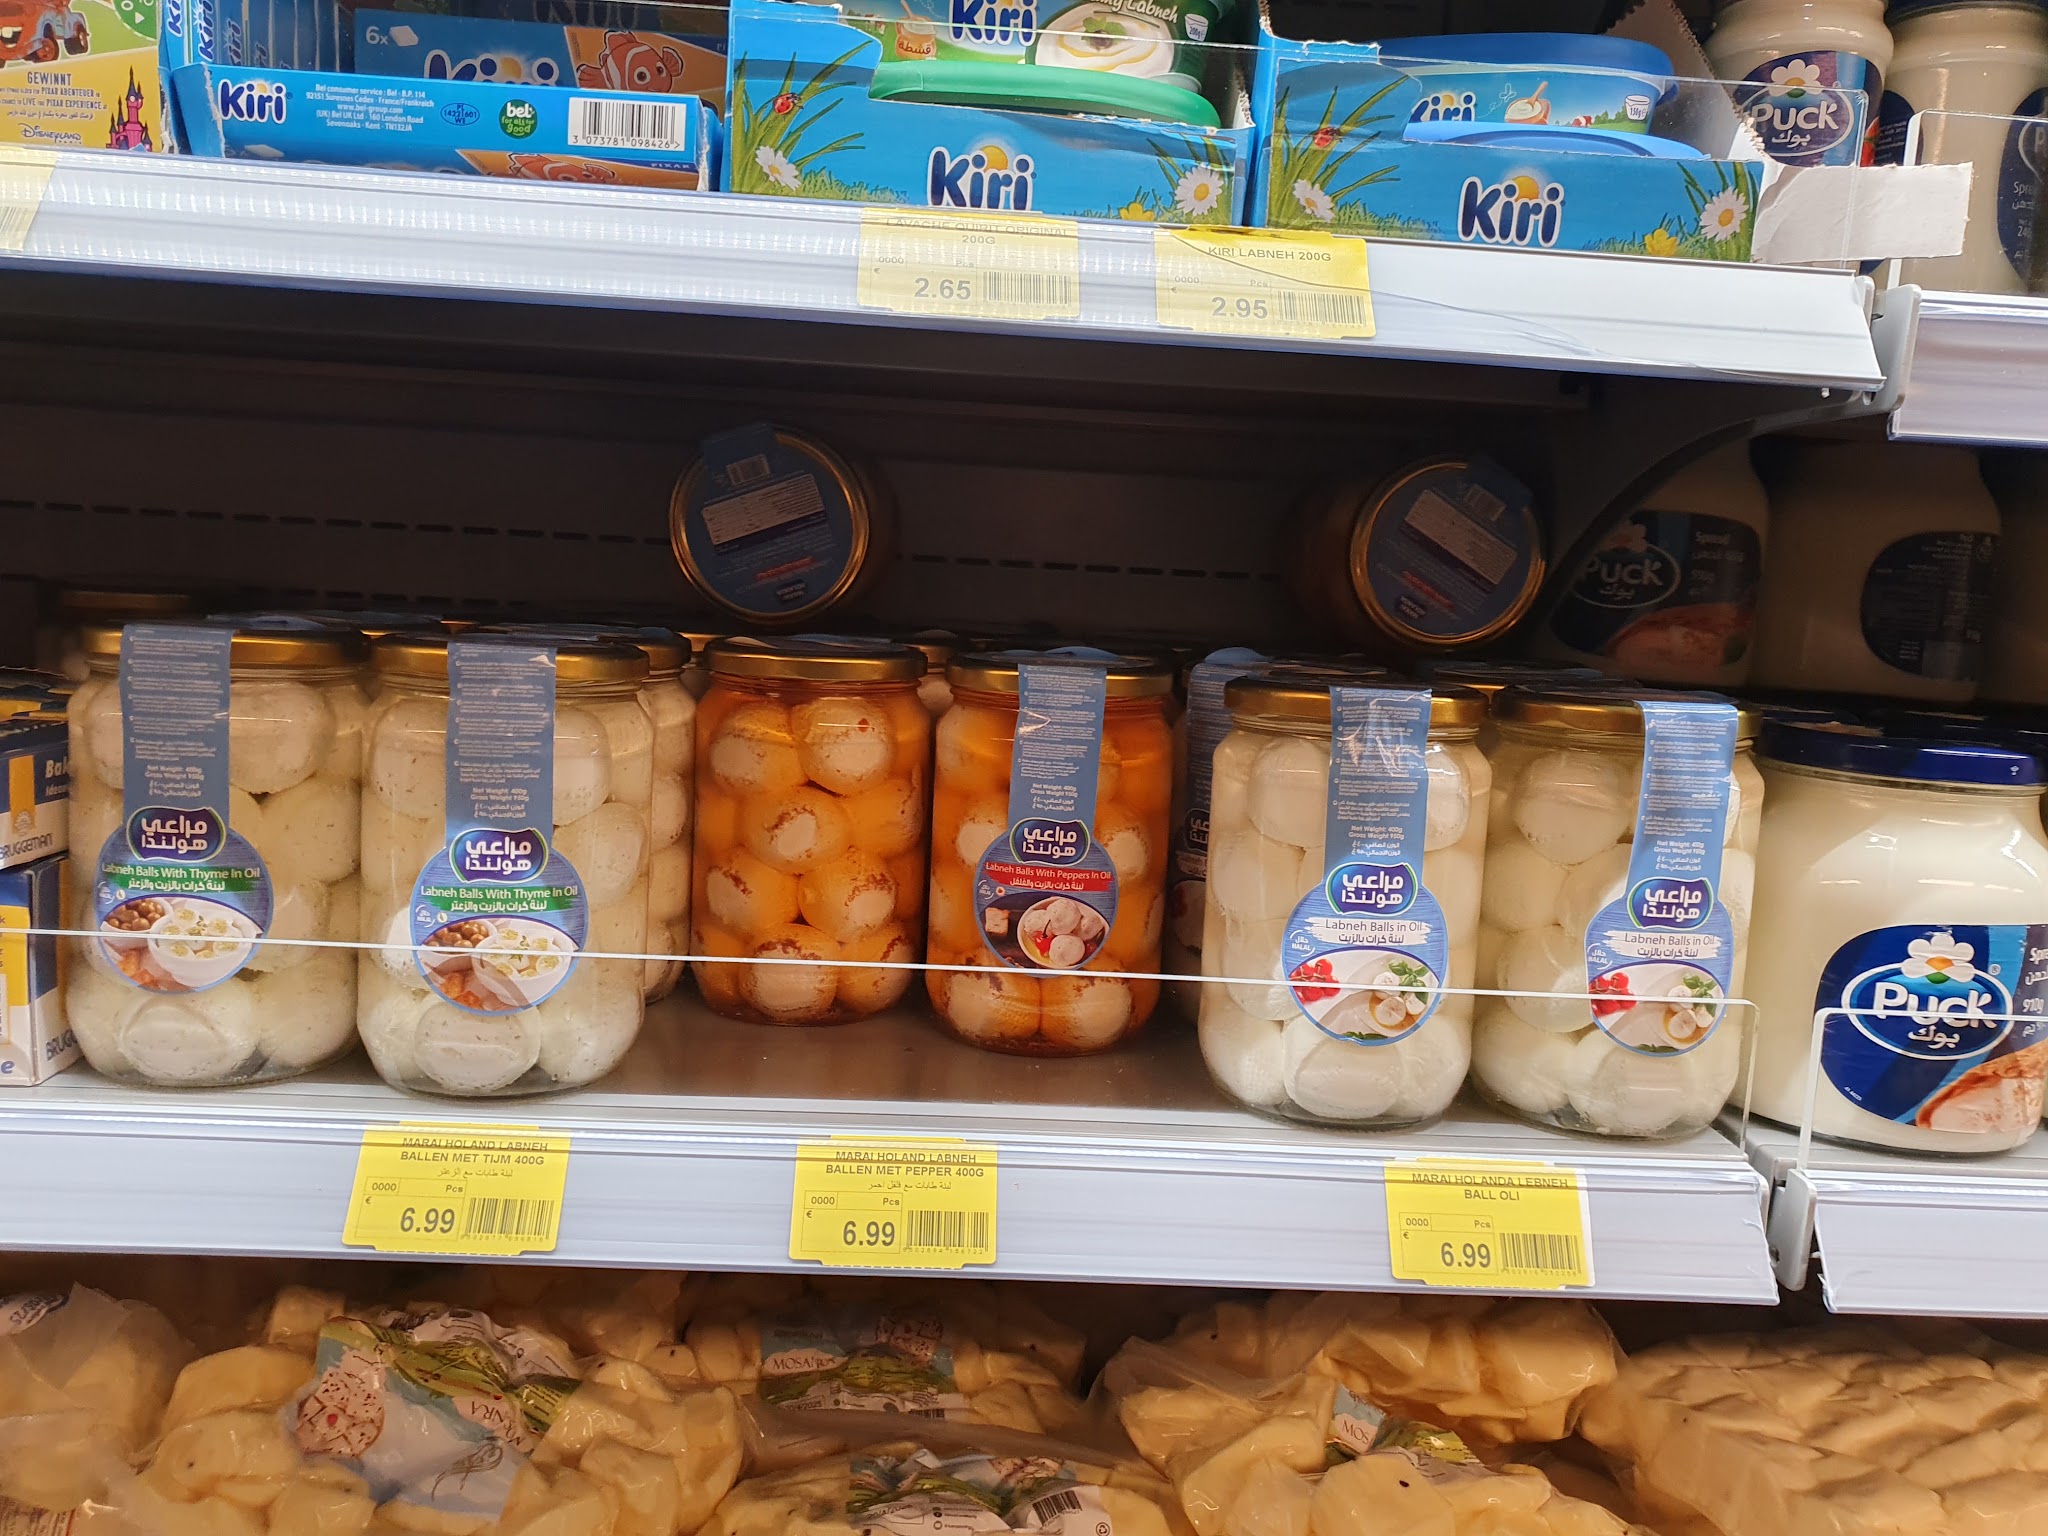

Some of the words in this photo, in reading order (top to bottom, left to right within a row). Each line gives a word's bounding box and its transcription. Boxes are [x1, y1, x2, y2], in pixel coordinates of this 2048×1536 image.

[1127, 0, 1178, 24] Labneh
[949, 0, 1037, 46] Kiri
[365, 26, 389, 46] 6x
[898, 40, 932, 55] قشطة
[27, 71, 72, 86] GEWINNT
[219, 79, 287, 124] Kiri
[1750, 99, 1840, 131] Puck
[1772, 130, 1811, 148] بوك
[928, 145, 1036, 212] Kiri
[1458, 176, 1565, 248] Kiri
[962, 235, 996, 245] 200G
[1208, 246, 1236, 257] KIRI
[1239, 249, 1295, 260] LABNEH
[1298, 251, 1332, 262] 200G
[1175, 276, 1200, 284] 0000
[915, 277, 972, 300] 2.65
[1211, 296, 1268, 319] 2.95
[141, 815, 208, 838] مراعي
[1023, 826, 1077, 846] مراعي
[465, 836, 532, 860] مراعي
[136, 866, 159, 877] Balls
[161, 867, 187, 879] With
[189, 868, 229, 882] Thyme
[244, 867, 261, 878] Oil
[985, 862, 1014, 874] Labneh
[1015, 867, 1034, 876] Balls
[1036, 868, 1056, 877] With
[1057, 871, 1090, 882] Peppers
[1100, 871, 1111, 879] Oil
[1342, 871, 1404, 894] مراعي
[420, 885, 458, 898] Labneh
[459, 888, 484, 899] Balls
[485, 889, 512, 899] With
[513, 888, 551, 902] Thyme
[552, 888, 562, 897] In
[564, 885, 578, 896] Oil
[1644, 886, 1702, 907] مراعي
[479, 901, 505, 913] بالزيت
[530, 900, 548, 911] لبنة
[1325, 919, 1367, 932] Labneh
[1370, 921, 1395, 932] Balls
[1397, 922, 1407, 932] in
[1408, 921, 1423, 932] Oil
[1338, 933, 1365, 945] بالزيت
[1365, 934, 1387, 945] كرات
[1388, 935, 1405, 945] لبنة
[1625, 933, 1666, 946] Labneh
[1668, 936, 1691, 946] Balls
[1692, 936, 1701, 945] in
[1703, 936, 1715, 945] Oil
[1637, 947, 1662, 958] بالزيت
[1664, 948, 1683, 959] كرات
[1684, 949, 1699, 959] لبنة
[1872, 982, 1997, 1029] Puck
[1907, 1025, 1960, 1049] بوك
[402, 1137, 442, 1148] MARAI
[446, 1139, 496, 1149] HOLAND
[499, 1141, 549, 1152] LABNEH
[400, 1151, 449, 1162] BALLEN
[452, 1153, 480, 1163] MET
[482, 1154, 511, 1165] TIJM
[514, 1155, 545, 1166] 400G
[836, 1151, 874, 1161] MARAI
[878, 1152, 926, 1162] HOLAND
[929, 1153, 976, 1164] LABNEH
[826, 1165, 872, 1175] BALLEN
[875, 1166, 902, 1175] MET
[905, 1167, 952, 1177] PEPPER
[955, 1167, 984, 1177] 400G
[372, 1182, 397, 1192] 0000
[445, 1184, 464, 1193] Pcs
[1412, 1173, 1451, 1183] MARAI
[1455, 1175, 1515, 1186] HOLANDA
[1518, 1177, 1569, 1188] LEBNEH
[811, 1197, 835, 1206] 0000
[883, 1198, 900, 1206] Pcs
[1464, 1189, 1497, 1200] BALL
[1499, 1191, 1520, 1201] OLI
[400, 1207, 455, 1234] 6.99
[1405, 1218, 1429, 1226] 0000
[1474, 1220, 1491, 1229] Pcs
[843, 1221, 895, 1246] 6.99
[1441, 1242, 1491, 1268] 6.99
